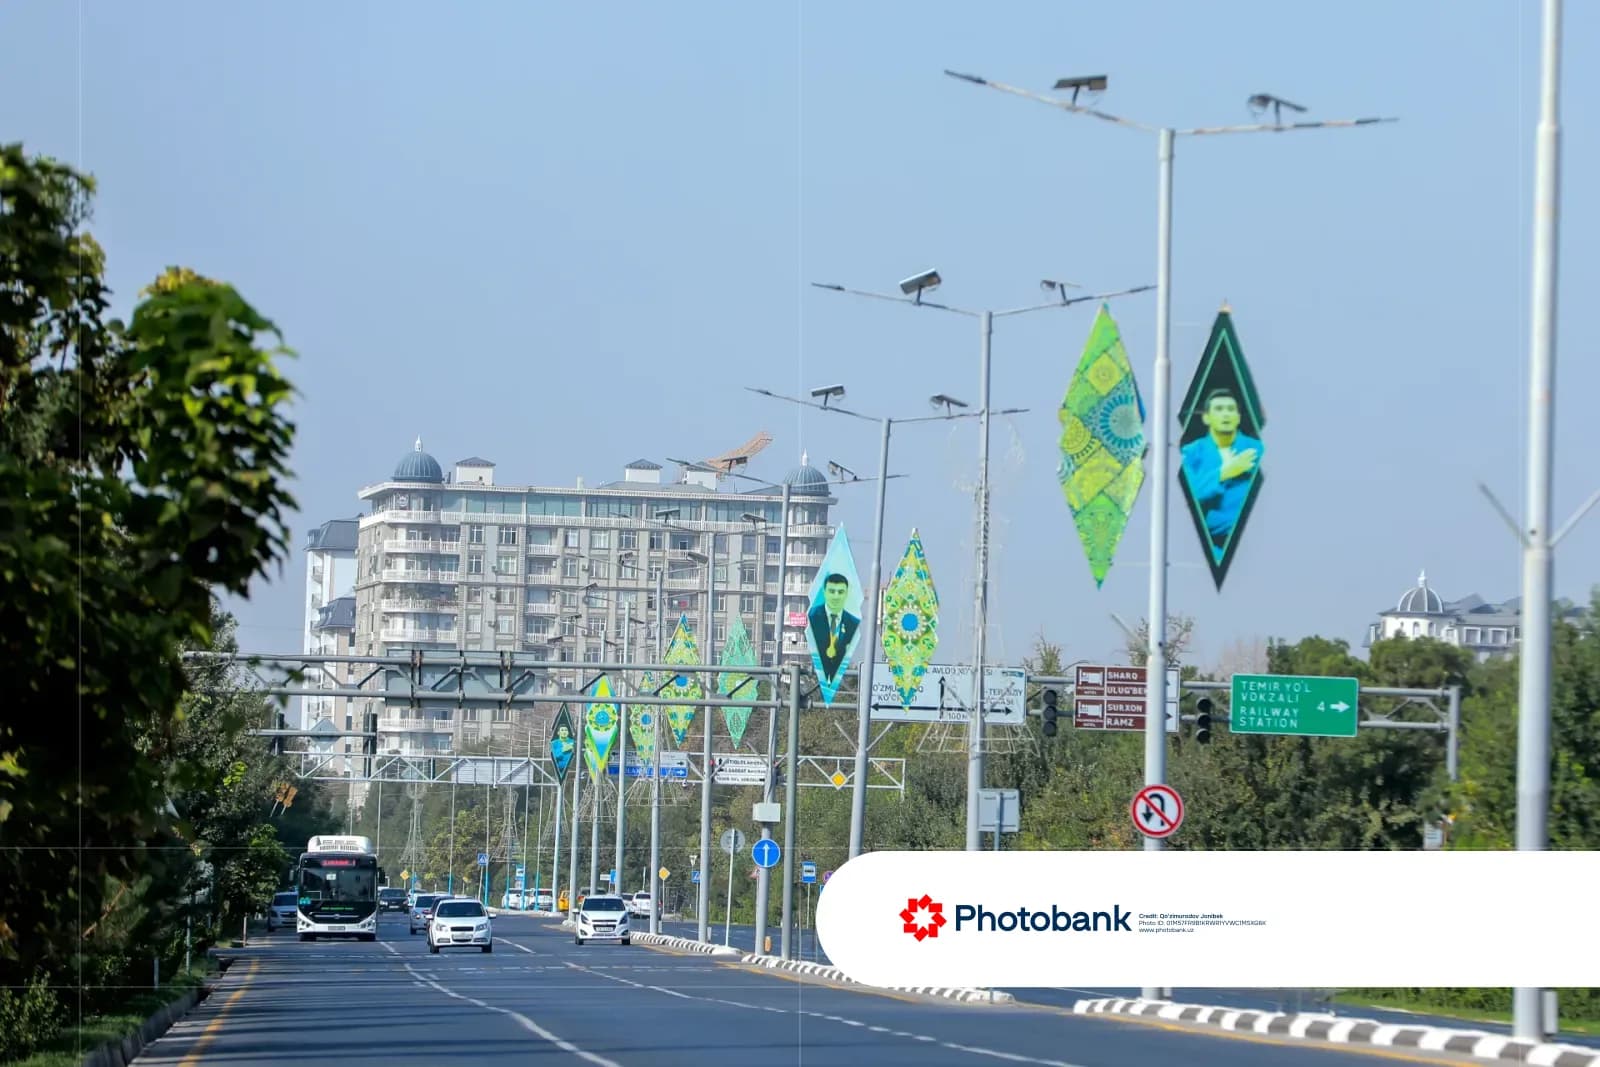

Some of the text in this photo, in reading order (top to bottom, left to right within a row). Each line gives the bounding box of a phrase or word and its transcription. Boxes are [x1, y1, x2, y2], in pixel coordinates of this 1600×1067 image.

[1107, 671, 1138, 680] SHARQ
[1107, 687, 1147, 695] ULUG'BE
[1241, 681, 1280, 691] TEMIR
[1241, 692, 1299, 703] VOKZALI
[1107, 703, 1143, 713] SURXON
[1240, 706, 1299, 717] RAILWAY
[1316, 701, 1325, 712] 4
[1106, 718, 1135, 727] RAMZ
[1239, 717, 1298, 728] STATION
